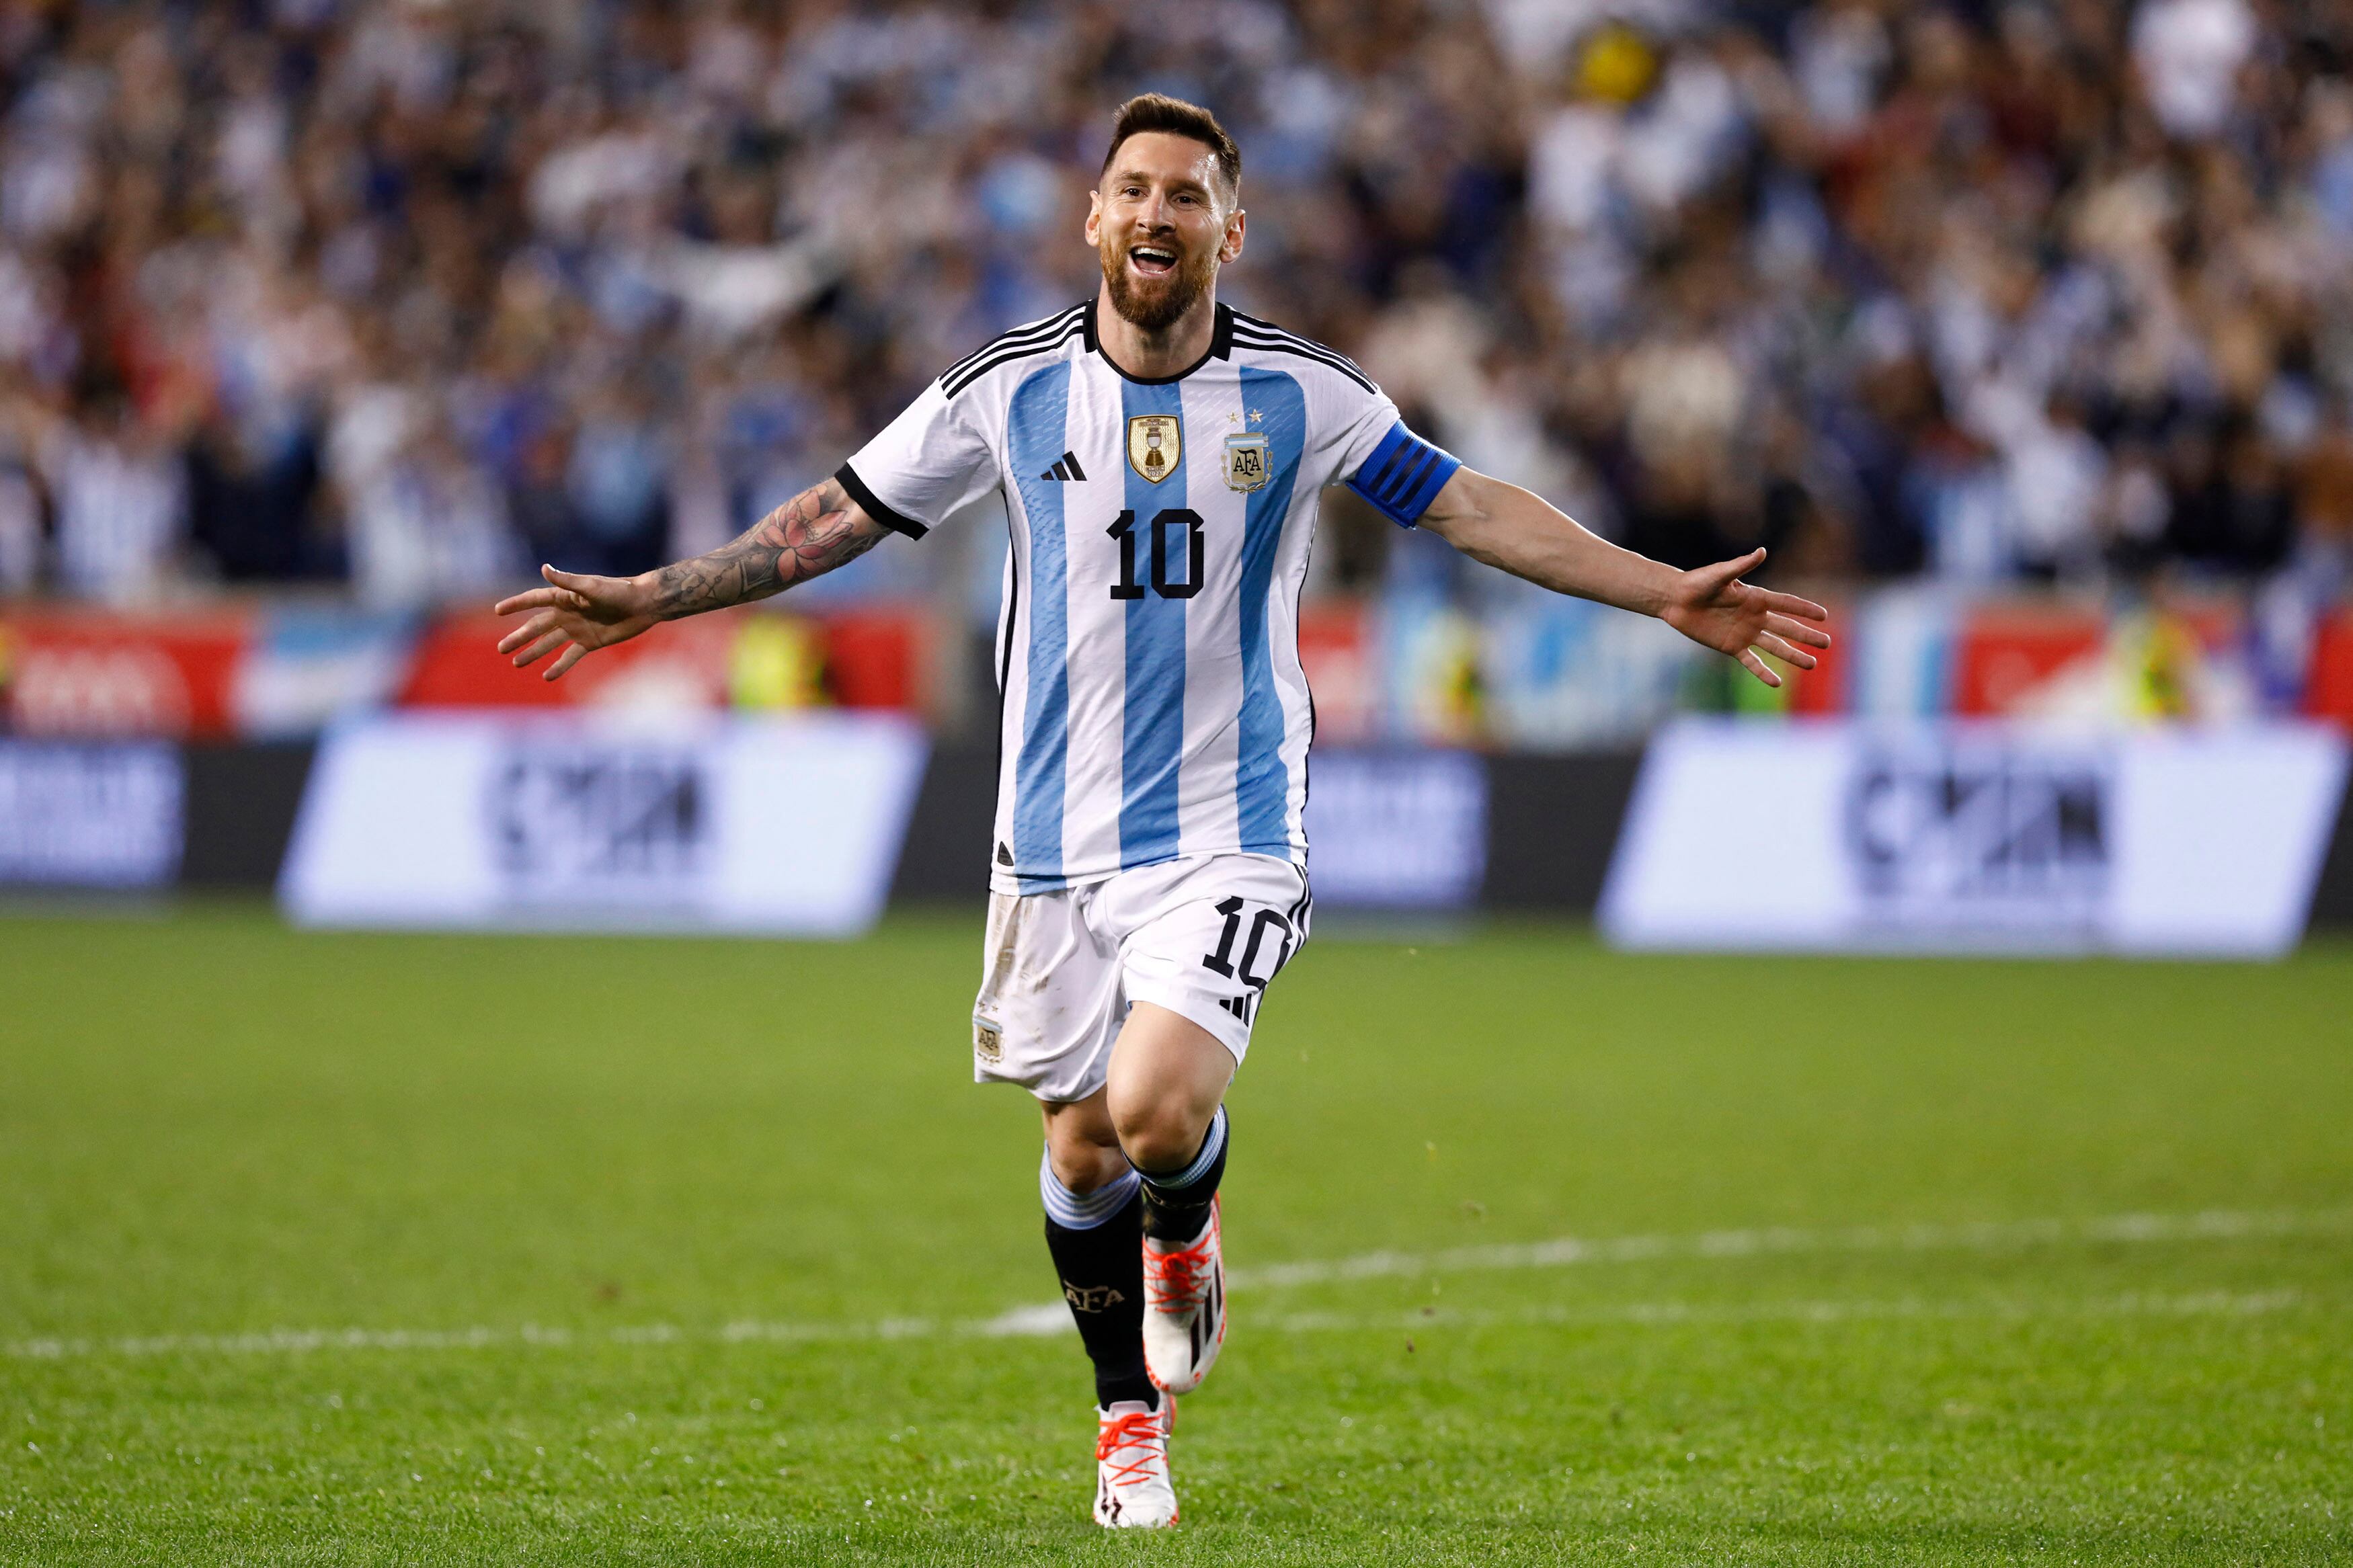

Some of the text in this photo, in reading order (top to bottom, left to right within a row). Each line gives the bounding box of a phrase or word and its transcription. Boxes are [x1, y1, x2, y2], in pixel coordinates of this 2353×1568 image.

[1233, 449, 1261, 477] AFA
[1106, 509, 1204, 600] 10
[1202, 896, 1293, 991] 10
[978, 1027, 999, 1050] AFA
[1064, 1279, 1125, 1314] AFA
